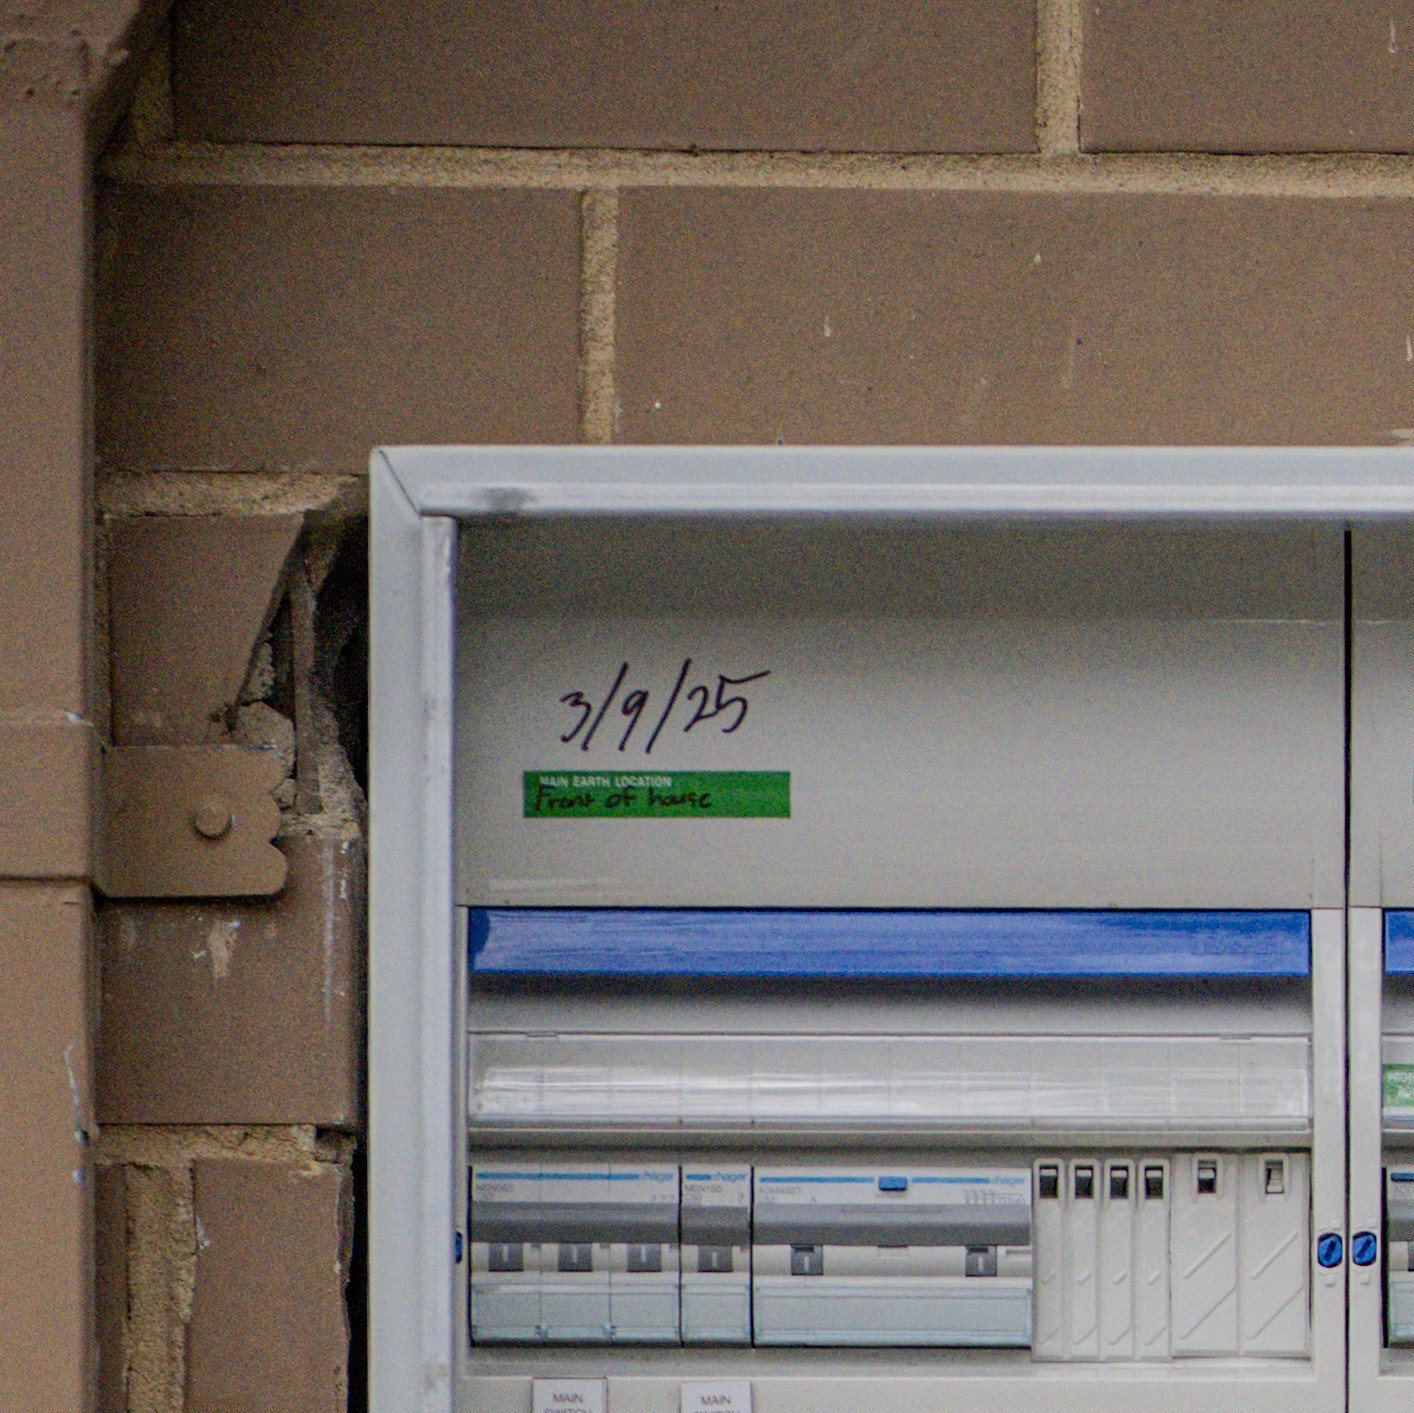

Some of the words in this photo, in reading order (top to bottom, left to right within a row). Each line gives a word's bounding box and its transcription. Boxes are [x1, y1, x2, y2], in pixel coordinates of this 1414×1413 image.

[560, 658, 771, 754] 3/9/25
[539, 776, 569, 787] MAIN
[573, 777, 610, 788] EARTH
[615, 777, 672, 788] LOCATION
[553, 1393, 583, 1403] MAIN
[701, 1395, 731, 1406] MAIN
